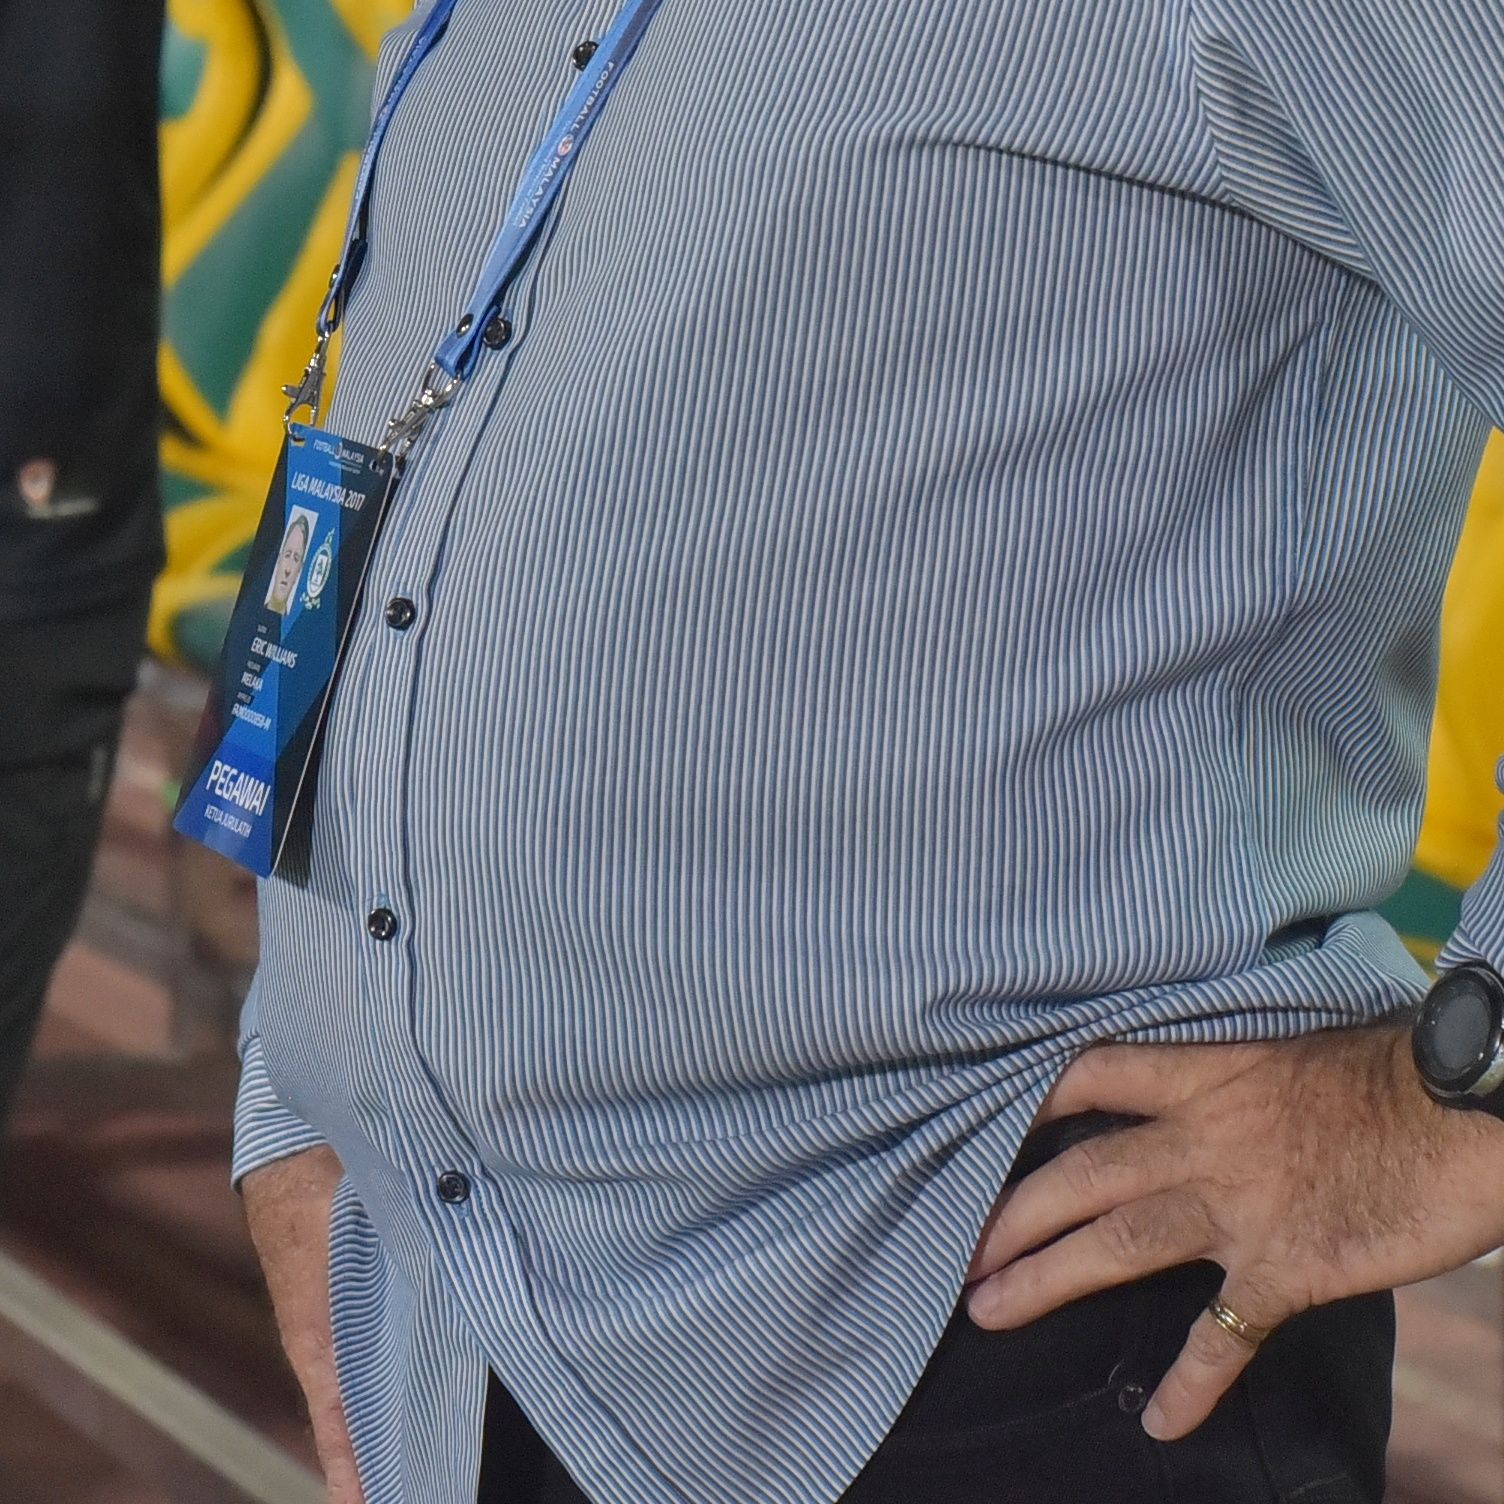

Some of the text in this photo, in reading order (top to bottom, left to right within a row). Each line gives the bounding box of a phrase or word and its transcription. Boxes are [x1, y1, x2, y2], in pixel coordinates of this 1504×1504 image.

[571, 61, 614, 132] FOOTBALL
[519, 156, 560, 228] MALAYSIA
[291, 471, 366, 511] LIGA MALAYSIA 2017
[251, 636, 267, 655] ERIC
[265, 642, 298, 669] WILLIAMS
[205, 759, 271, 816] PEGAWAI
